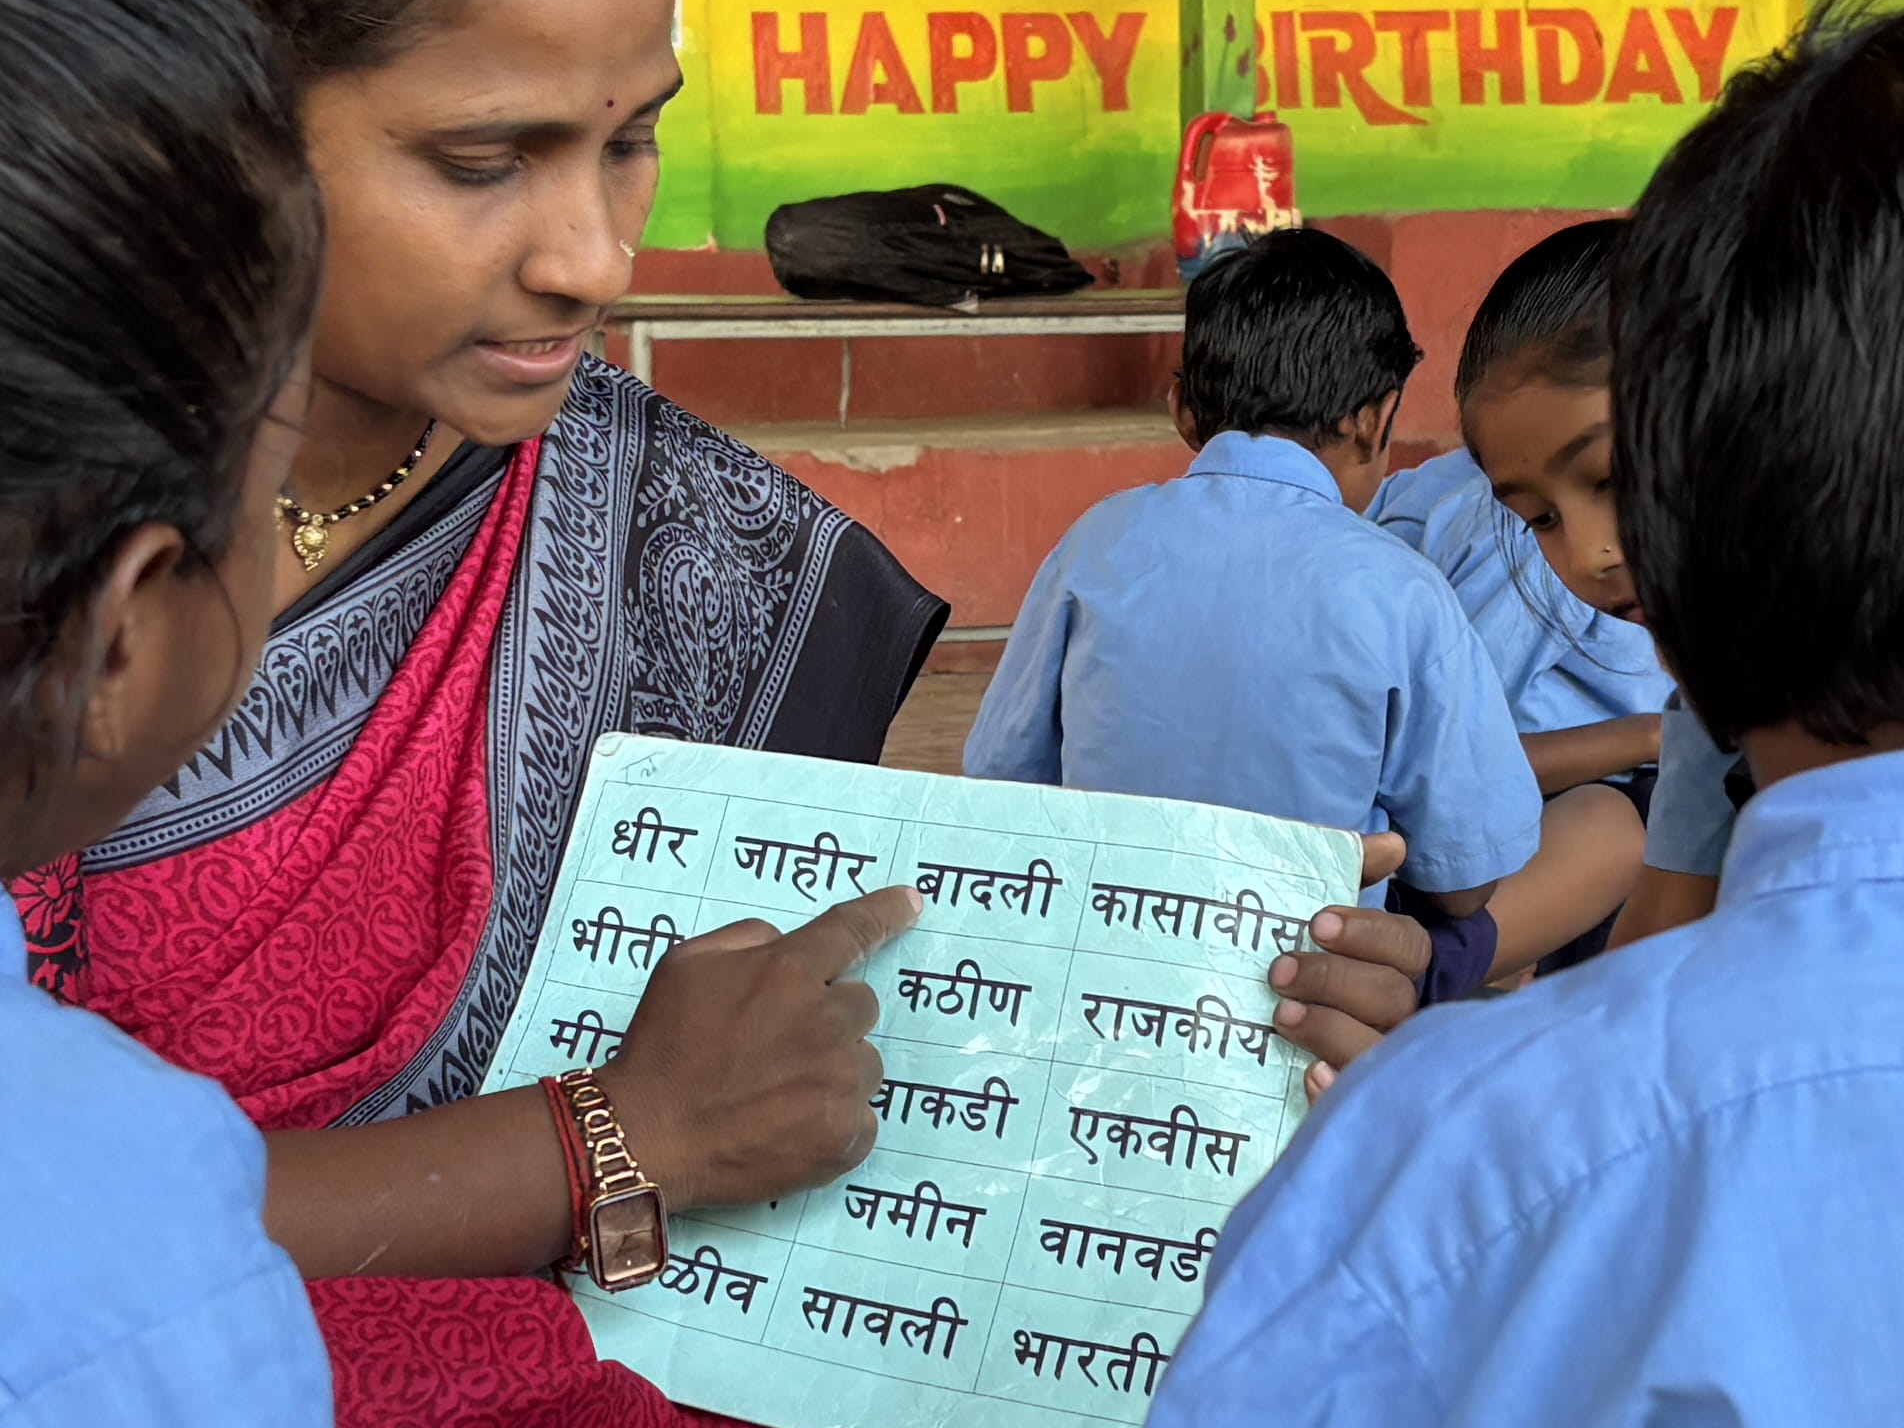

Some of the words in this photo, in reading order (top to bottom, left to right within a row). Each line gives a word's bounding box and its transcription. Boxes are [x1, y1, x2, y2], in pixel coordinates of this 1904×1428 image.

[750, 9, 1148, 117] HAPPY
[610, 806, 699, 869] धीर
[734, 831, 878, 903] जाहीर
[915, 858, 1063, 919] बादली
[1091, 888, 1310, 956] कासावीस
[897, 959, 1033, 1027] कठीण
[1081, 994, 1276, 1067] राजकीय
[549, 1009, 626, 1064] मी
[1068, 1104, 1251, 1178] एकवीस
[844, 1180, 988, 1250] जमीन
[658, 1245, 769, 1315] ळीव
[801, 1286, 970, 1360] सावली
[1013, 1328, 1172, 1398] भारती
